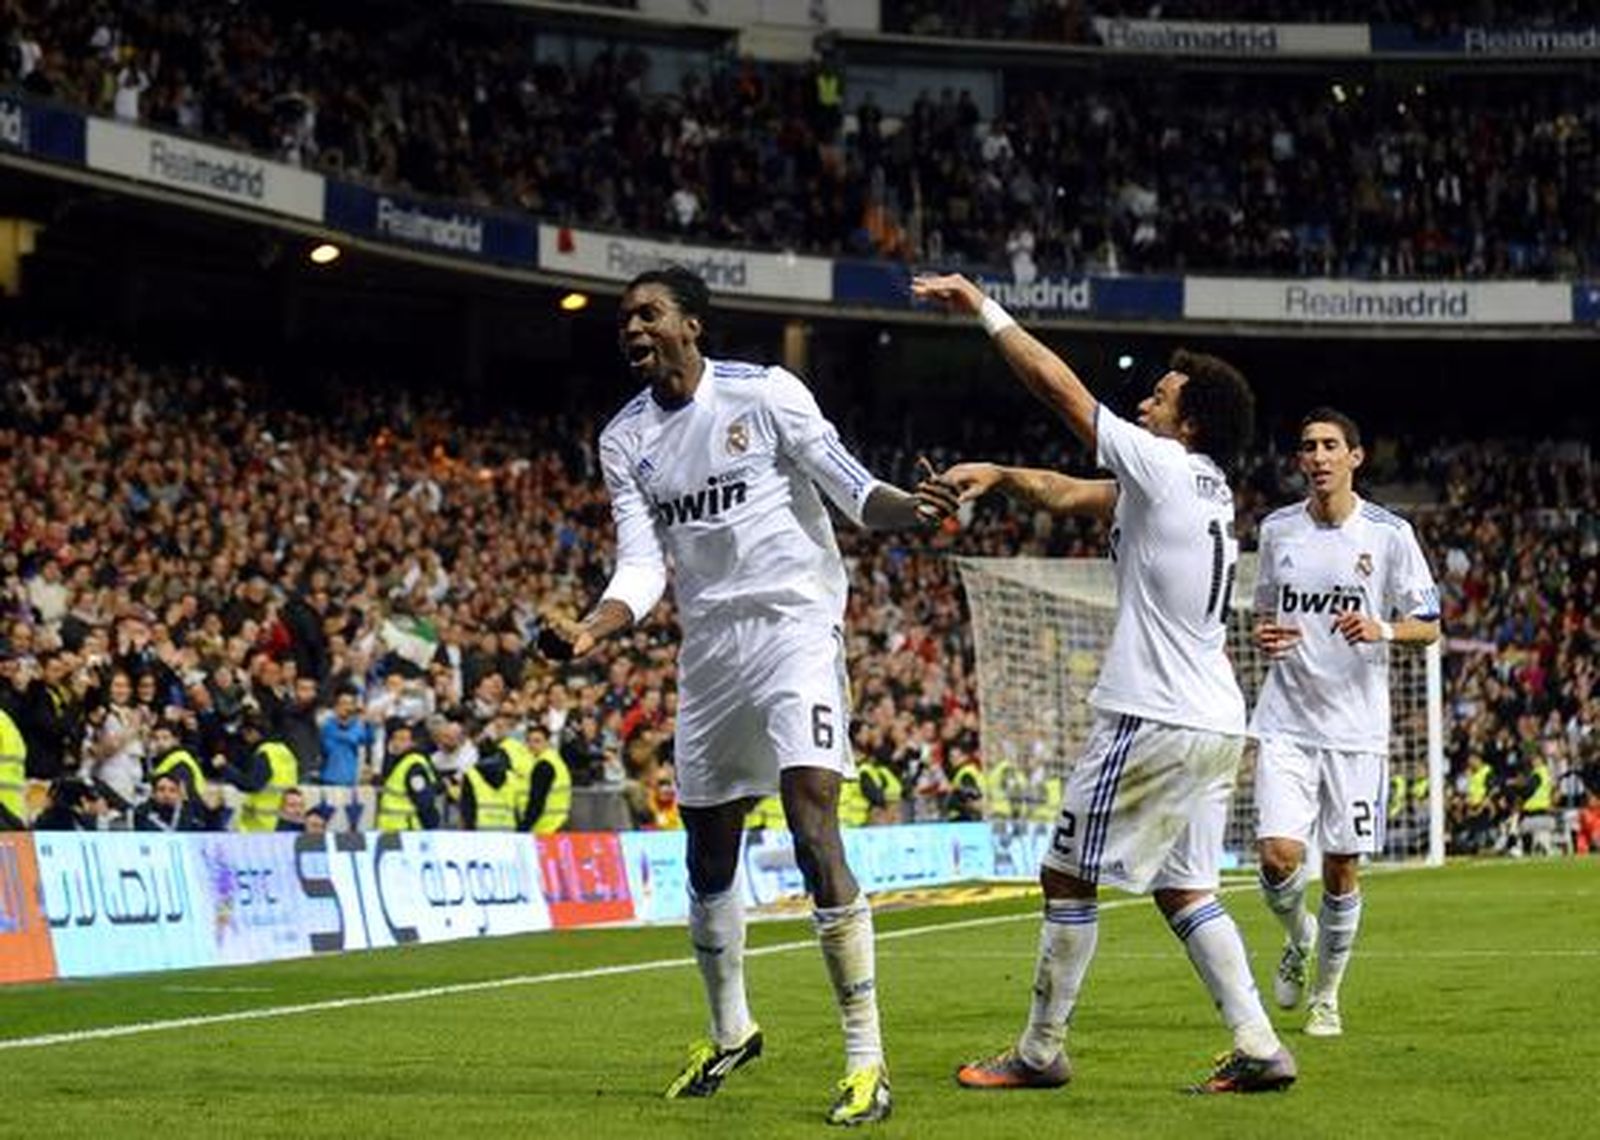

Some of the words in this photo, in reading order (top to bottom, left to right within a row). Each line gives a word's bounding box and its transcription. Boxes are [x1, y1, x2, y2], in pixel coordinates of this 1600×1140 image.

[149, 139, 265, 201] Realmadrid
[376, 196, 482, 252] Realmadrid
[1284, 285, 1468, 318] Realmadrid
[1281, 583, 1364, 614] bwin
[811, 704, 834, 750] 6
[1353, 800, 1372, 837] 2
[293, 832, 420, 952] STC
